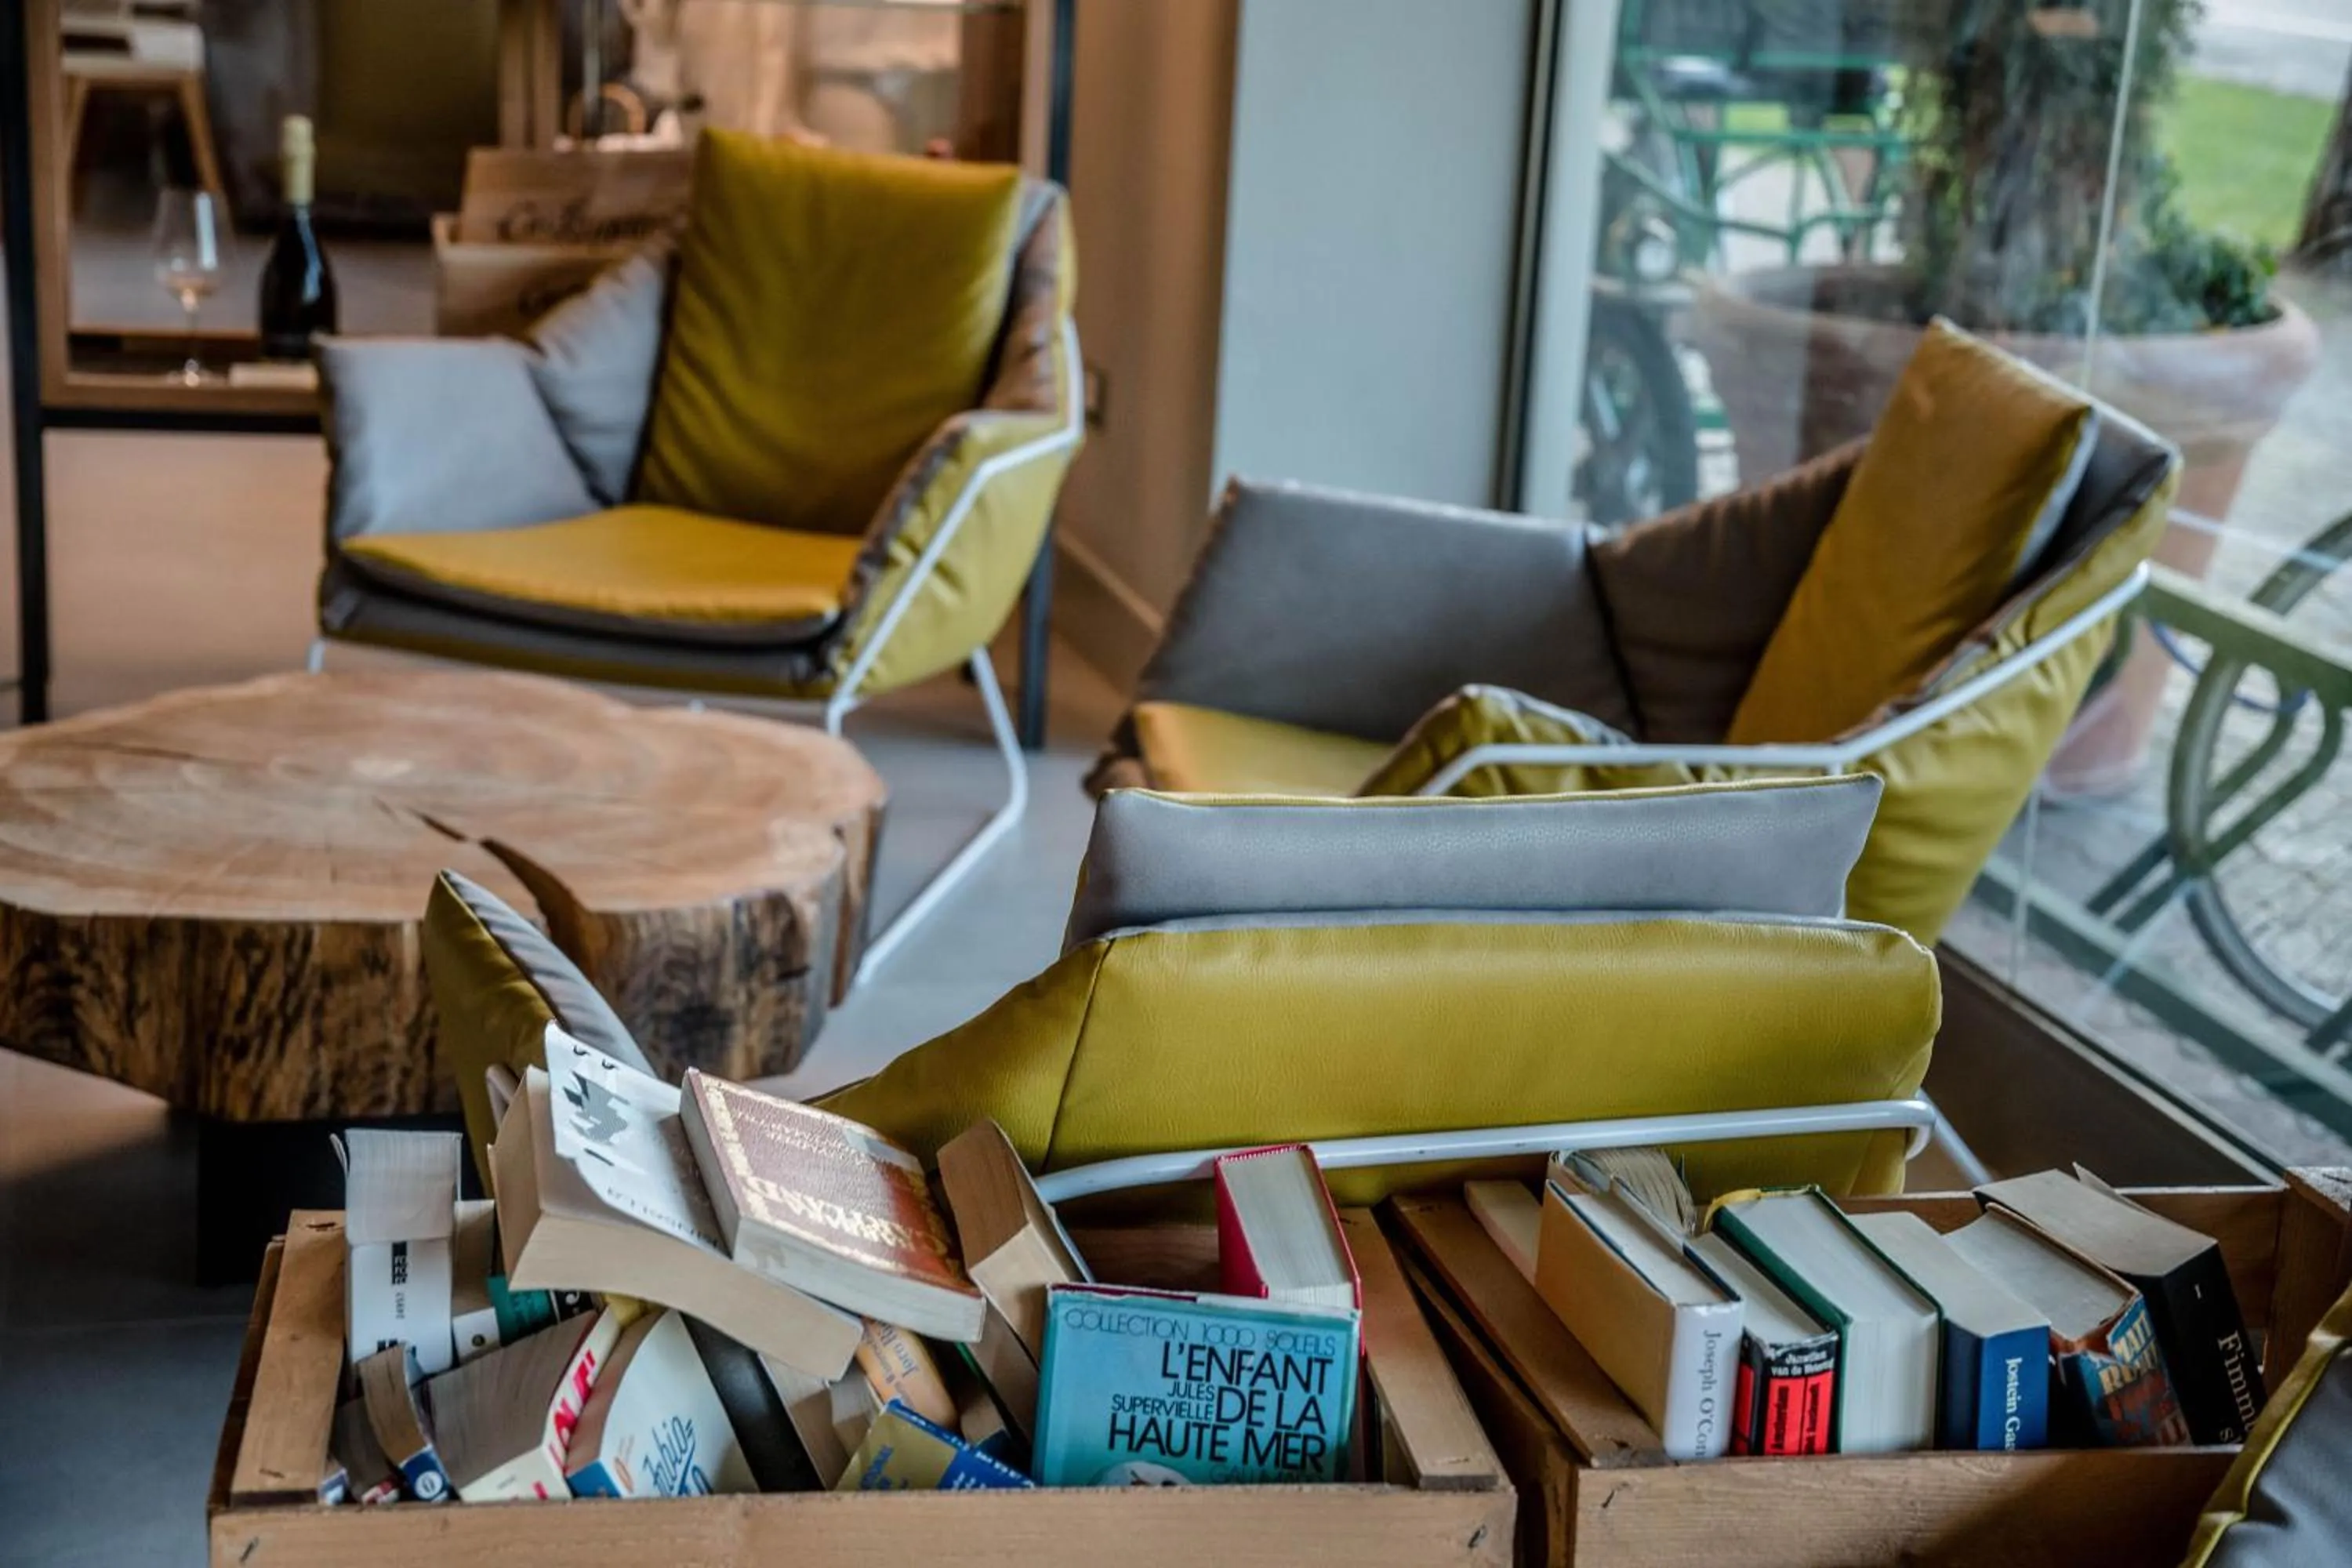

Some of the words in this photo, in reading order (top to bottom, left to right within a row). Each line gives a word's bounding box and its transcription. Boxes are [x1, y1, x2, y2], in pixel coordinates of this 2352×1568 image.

[1065, 1307, 1189, 1341] COLLECTION
[1203, 1323, 1256, 1347] 1000
[1266, 1328, 1336, 1356] SOLEILS
[1161, 1341, 1334, 1395] L'ENFANT
[1698, 1329, 1722, 1392] Joseph
[2005, 1356, 2024, 1414] Jostein
[1112, 1393, 1214, 1422] SUPERVIELLE
[1167, 1381, 1215, 1401] JULES
[1216, 1385, 1268, 1428] DE
[1275, 1390, 1327, 1435] LA
[1108, 1413, 1230, 1464] HAUTE
[1243, 1428, 1327, 1473] MER
